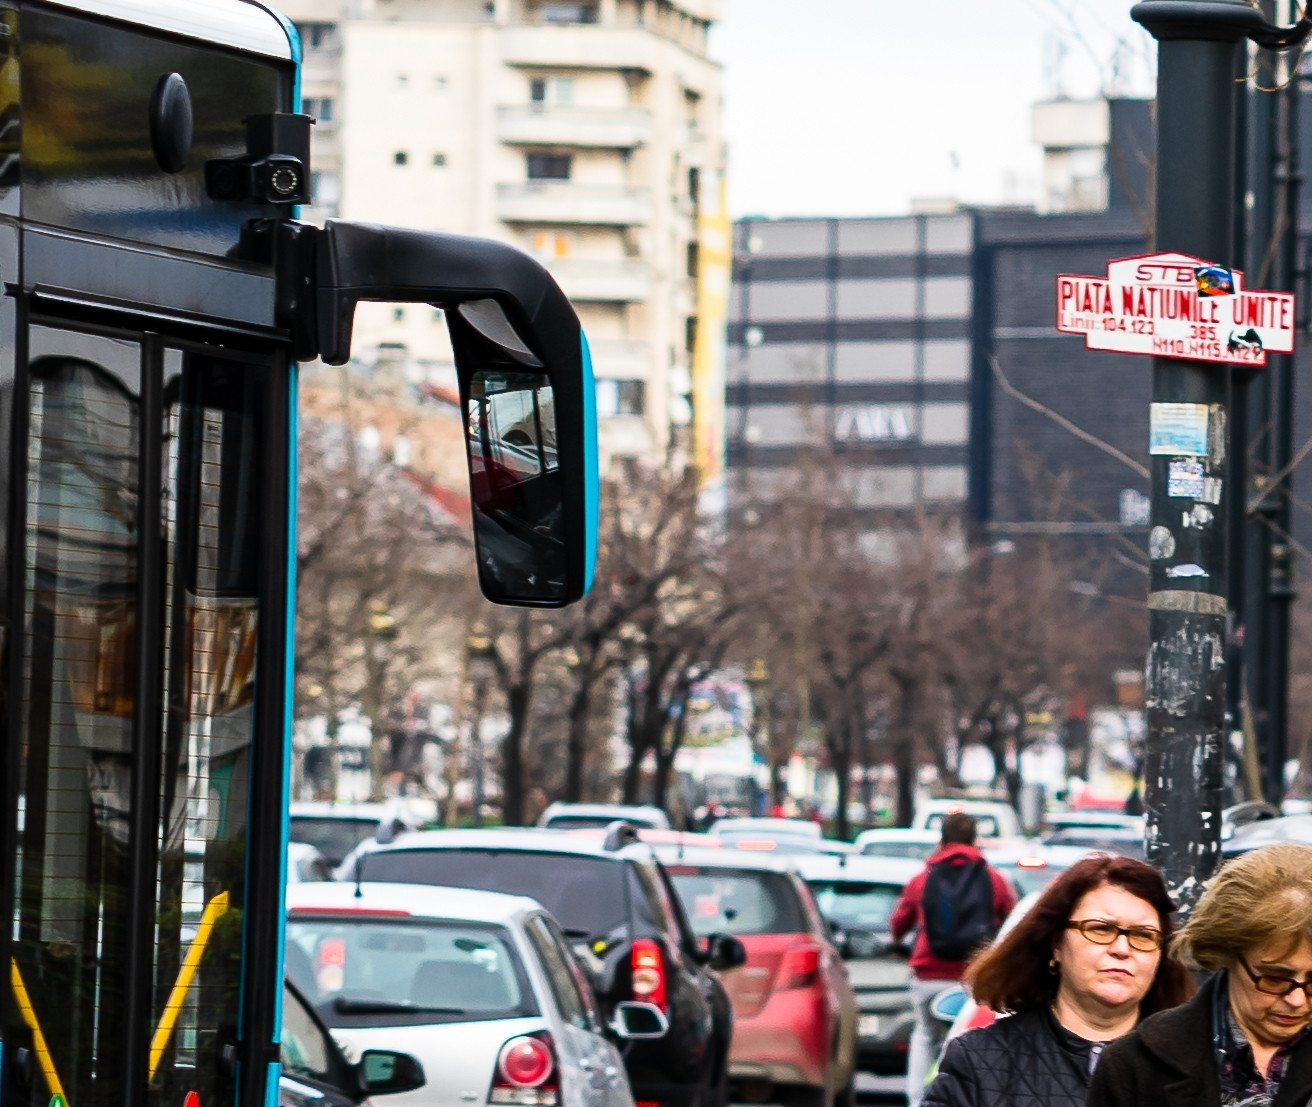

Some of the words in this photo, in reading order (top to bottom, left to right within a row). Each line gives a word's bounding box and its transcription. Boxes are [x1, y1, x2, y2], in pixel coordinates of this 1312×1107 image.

[1135, 265, 1194, 283] STB
[1062, 281, 1114, 315] PIATA
[1233, 294, 1290, 330] UNITE
